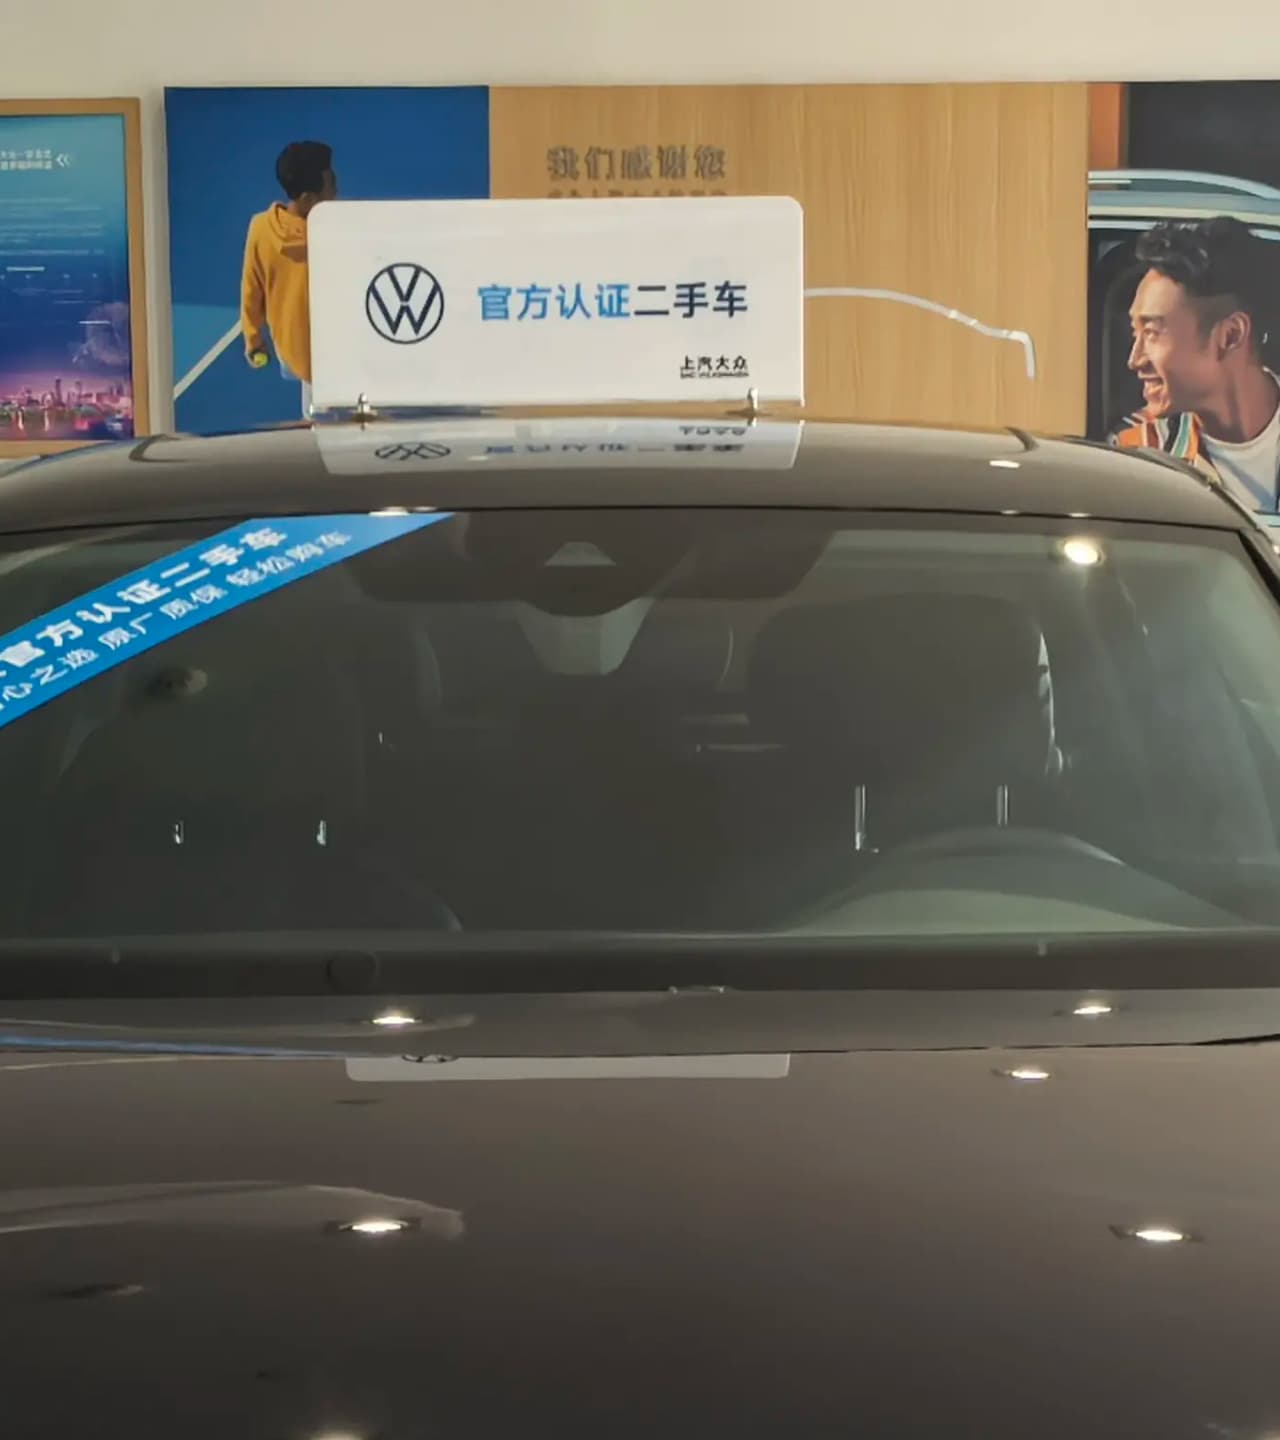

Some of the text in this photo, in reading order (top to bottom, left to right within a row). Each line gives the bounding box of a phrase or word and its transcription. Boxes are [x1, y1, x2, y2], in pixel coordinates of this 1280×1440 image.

[546, 145, 726, 180] 我们感谢您
[477, 280, 749, 322] 官方认证二手车
[680, 354, 748, 371] 上汽大众
